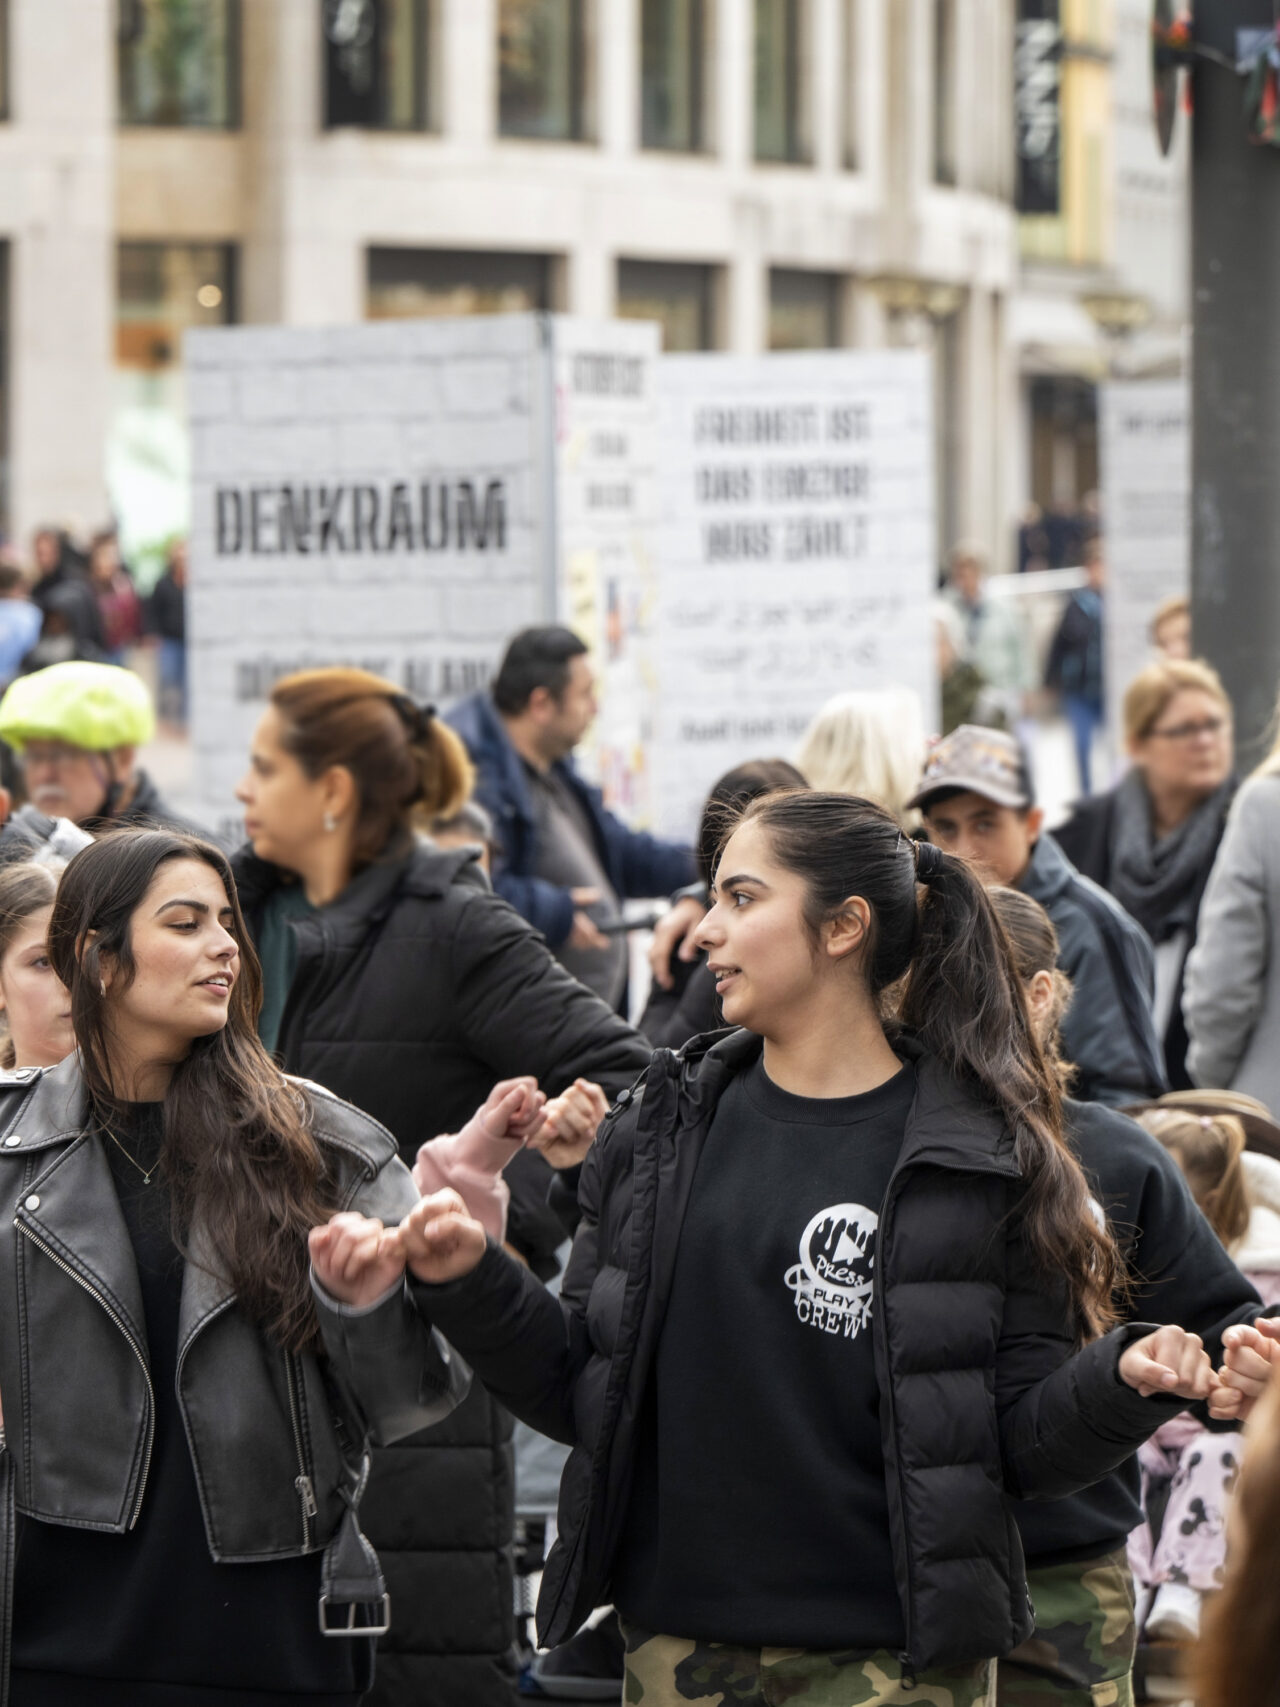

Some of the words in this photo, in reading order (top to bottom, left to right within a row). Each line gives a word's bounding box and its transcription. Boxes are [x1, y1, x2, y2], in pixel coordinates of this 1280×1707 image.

[216, 477, 508, 555] DENKRAUM
[797, 1298, 861, 1340] CREW
[814, 1288, 855, 1309] PLAY
